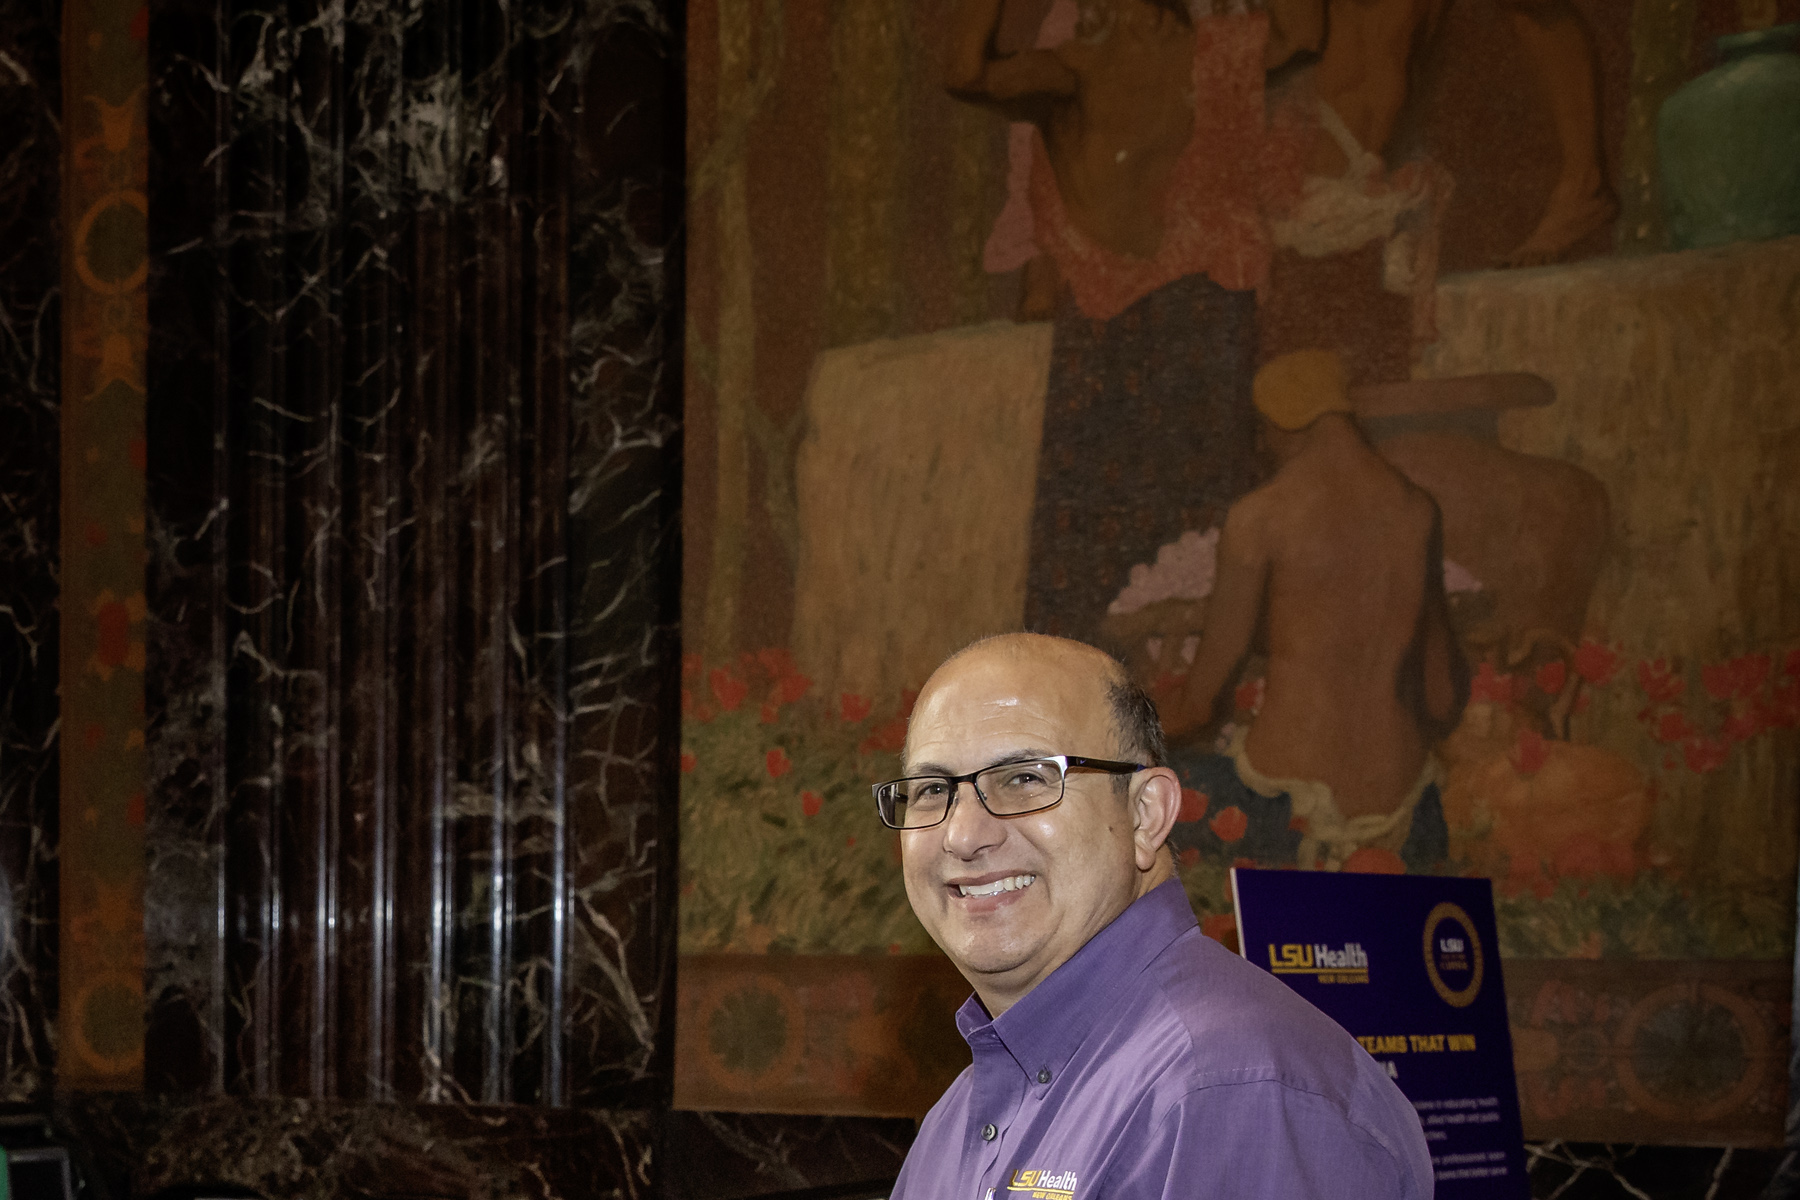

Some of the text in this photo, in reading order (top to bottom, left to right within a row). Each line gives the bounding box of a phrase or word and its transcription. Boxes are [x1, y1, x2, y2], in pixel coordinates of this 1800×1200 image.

[1268, 942, 1369, 969] LSU Health
[1409, 1035, 1446, 1053] THAT
[1009, 1169, 1078, 1191] LSU Health
